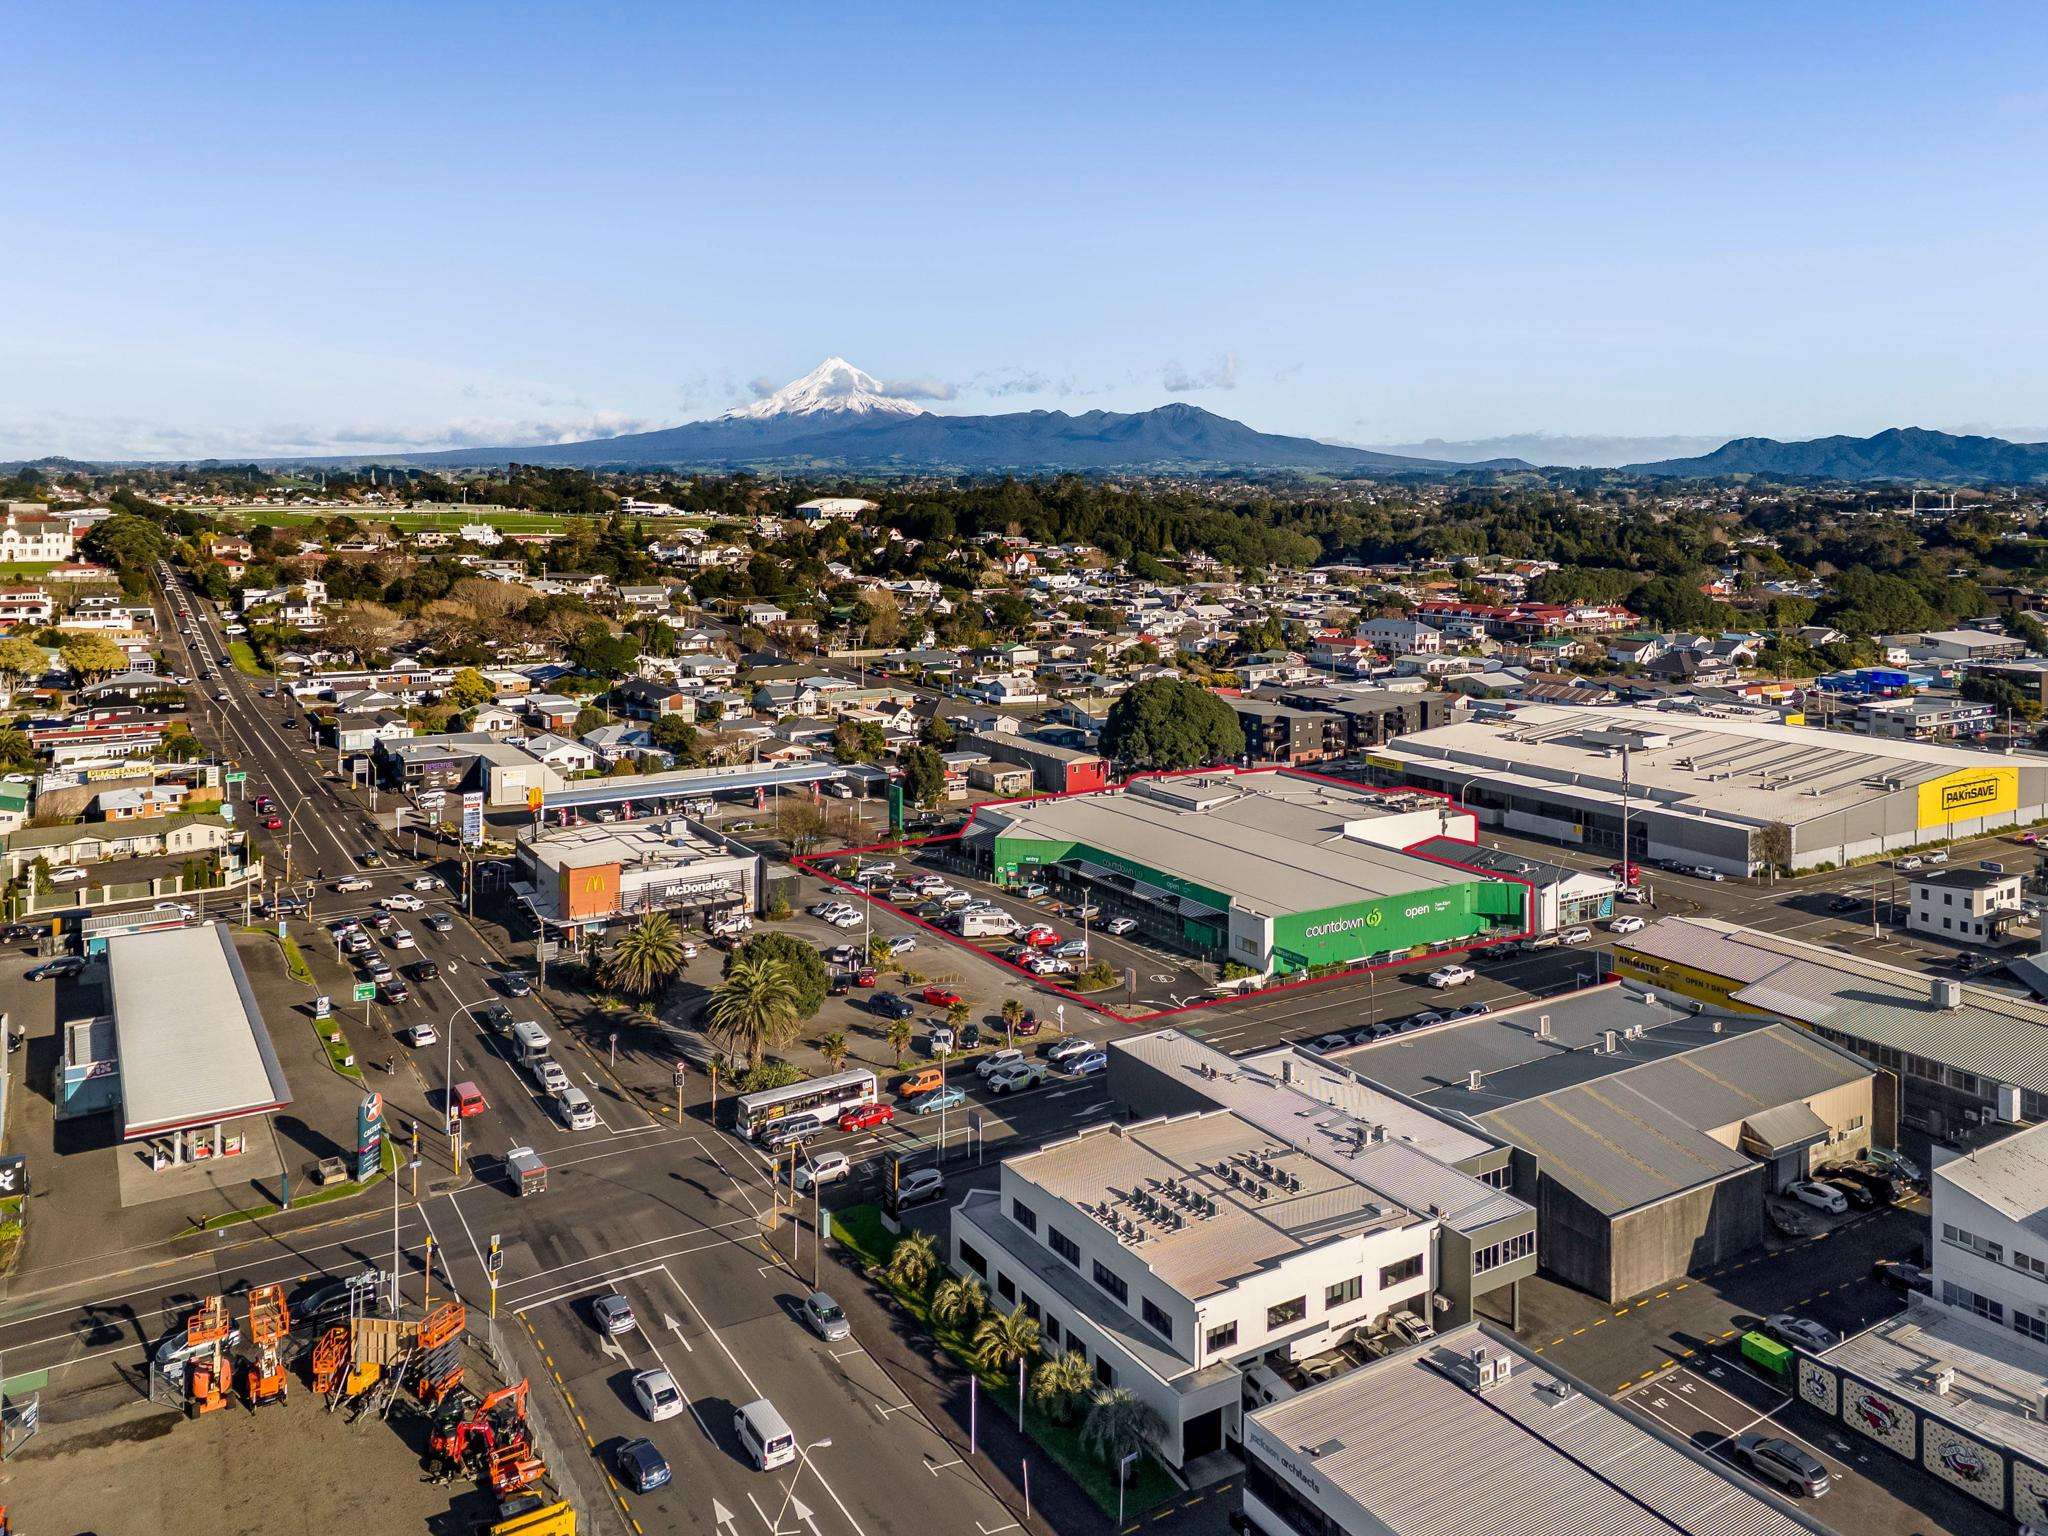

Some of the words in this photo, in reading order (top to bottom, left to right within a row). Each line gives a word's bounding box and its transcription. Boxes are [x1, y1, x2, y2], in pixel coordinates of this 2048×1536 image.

[665, 879, 730, 897] McDonald's
[1405, 904, 1430, 919] open
[1305, 916, 1364, 938] countdown
[1685, 976, 1704, 988] OPEN
[1280, 1457, 1320, 1494] architects
